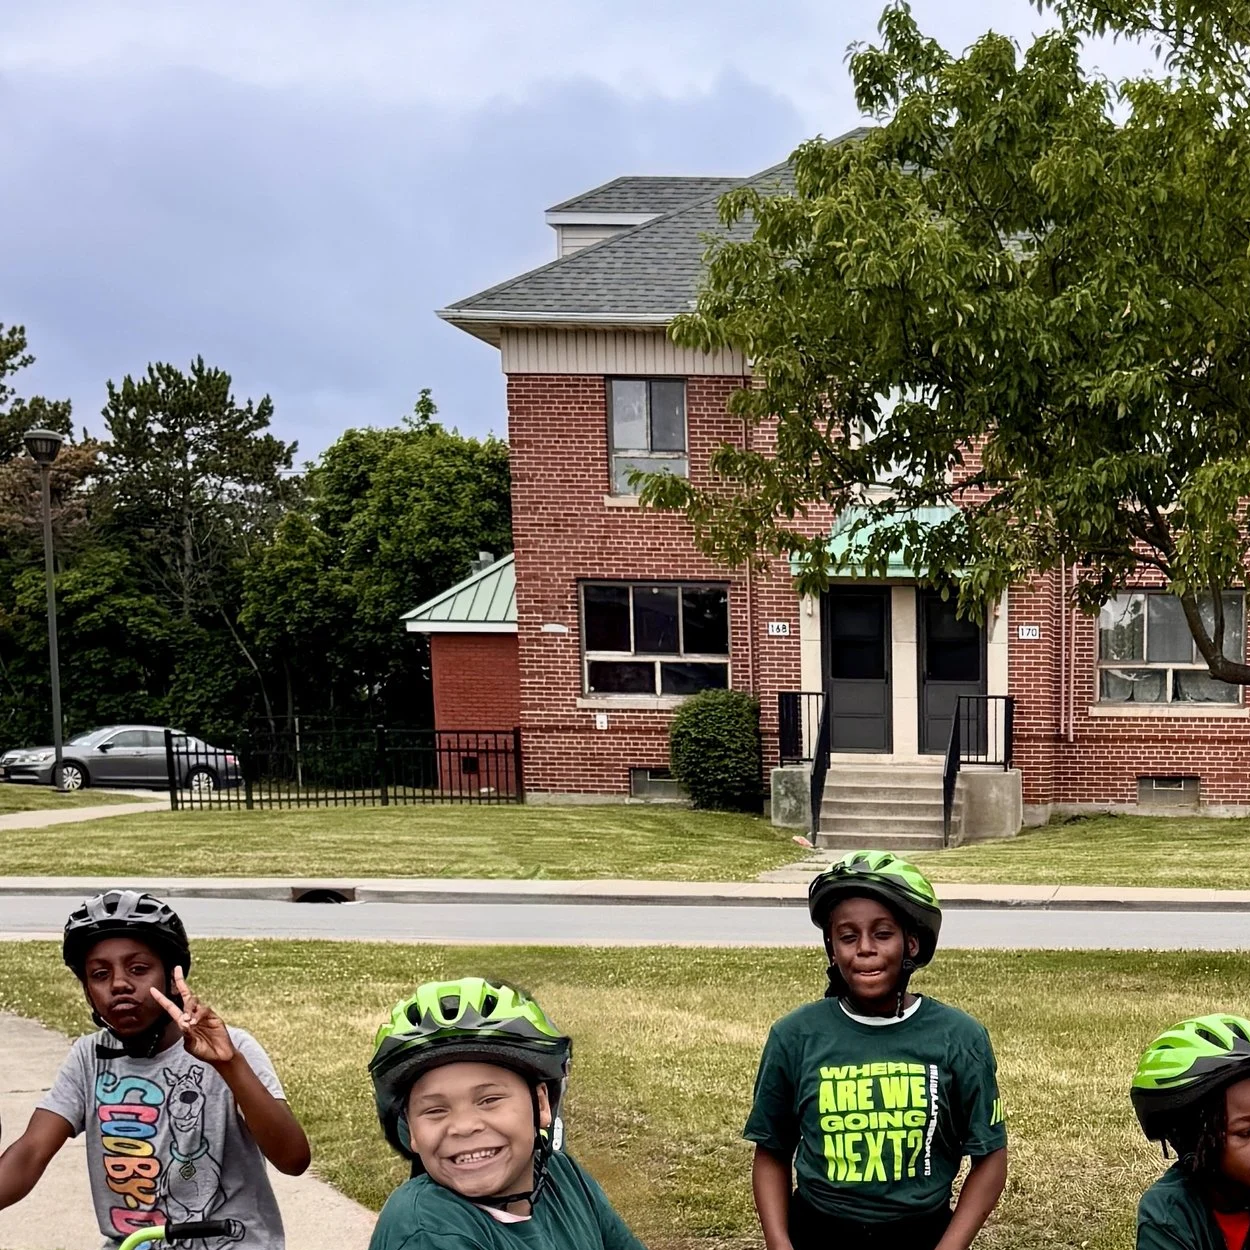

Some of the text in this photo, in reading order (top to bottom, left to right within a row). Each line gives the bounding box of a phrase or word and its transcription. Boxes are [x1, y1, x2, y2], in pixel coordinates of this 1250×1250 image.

[770, 623, 788, 634] 168
[1020, 627, 1038, 638] 170
[820, 1062, 926, 1079] WHERE
[819, 1076, 927, 1113] ARE WE
[820, 1110, 927, 1132] GOING
[824, 1129, 923, 1182] NEXT?
